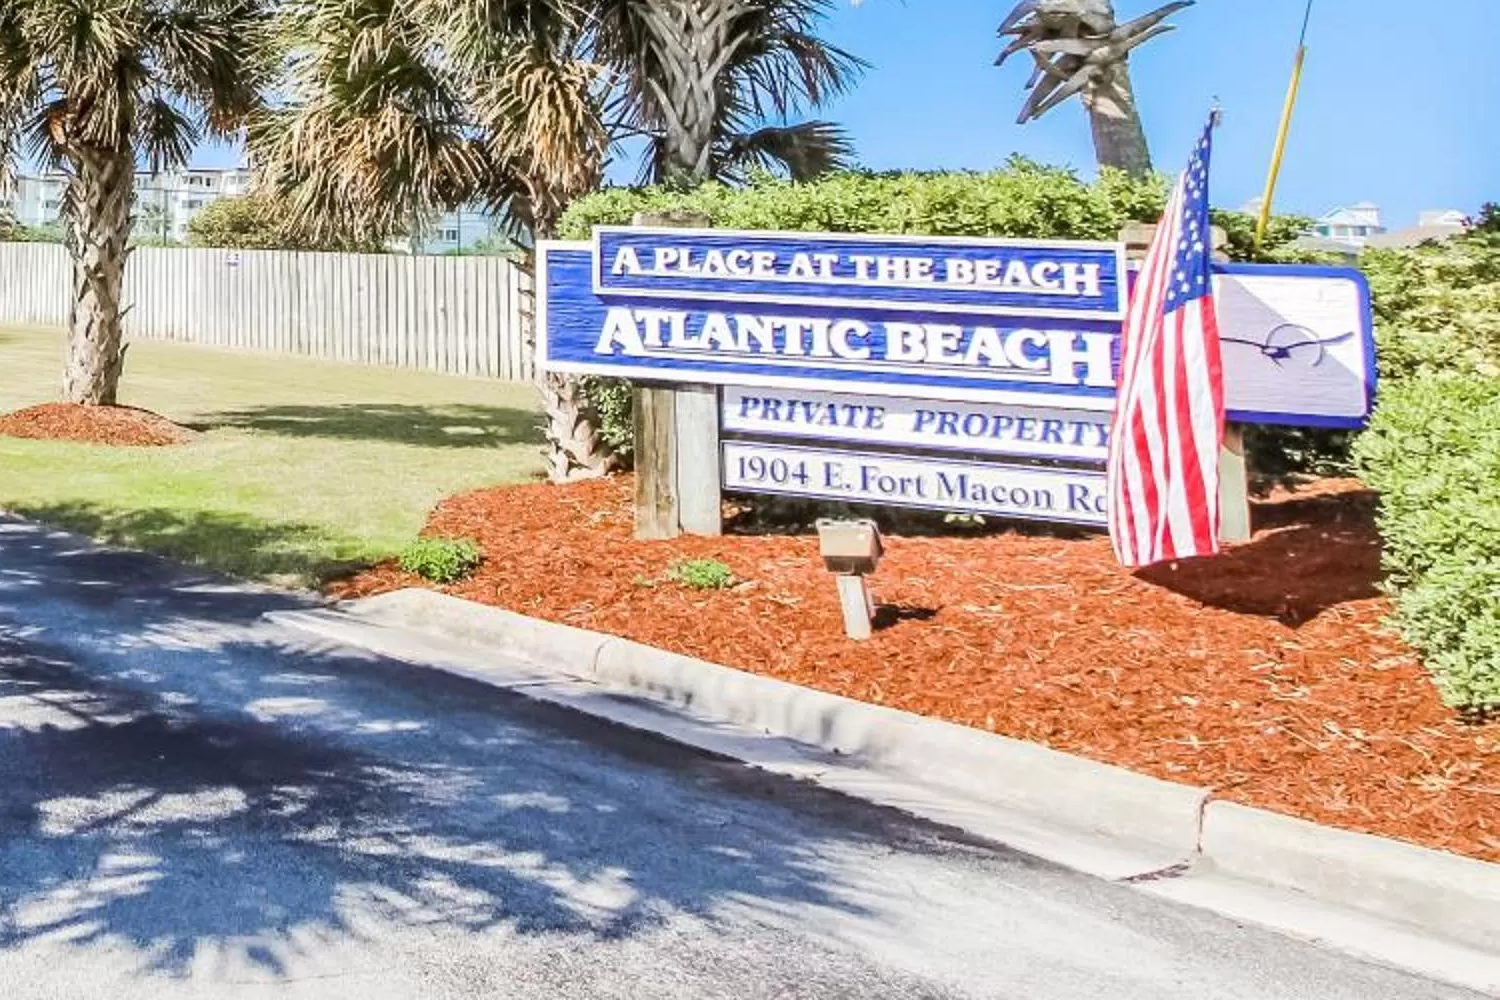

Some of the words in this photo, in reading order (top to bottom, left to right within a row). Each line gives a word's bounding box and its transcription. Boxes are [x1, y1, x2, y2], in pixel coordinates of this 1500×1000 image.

[654, 246, 776, 277] PLACE
[786, 252, 840, 282] AT
[850, 254, 933, 284] THE
[945, 257, 1101, 296] BEACH
[593, 306, 872, 360] ATLANTIC
[884, 320, 1117, 386] BEACH
[738, 395, 886, 429] PRIVATE
[738, 456, 810, 484] 1904
[824, 461, 852, 489] E.
[860, 464, 928, 498] Fort
[936, 470, 1052, 510] Macon
